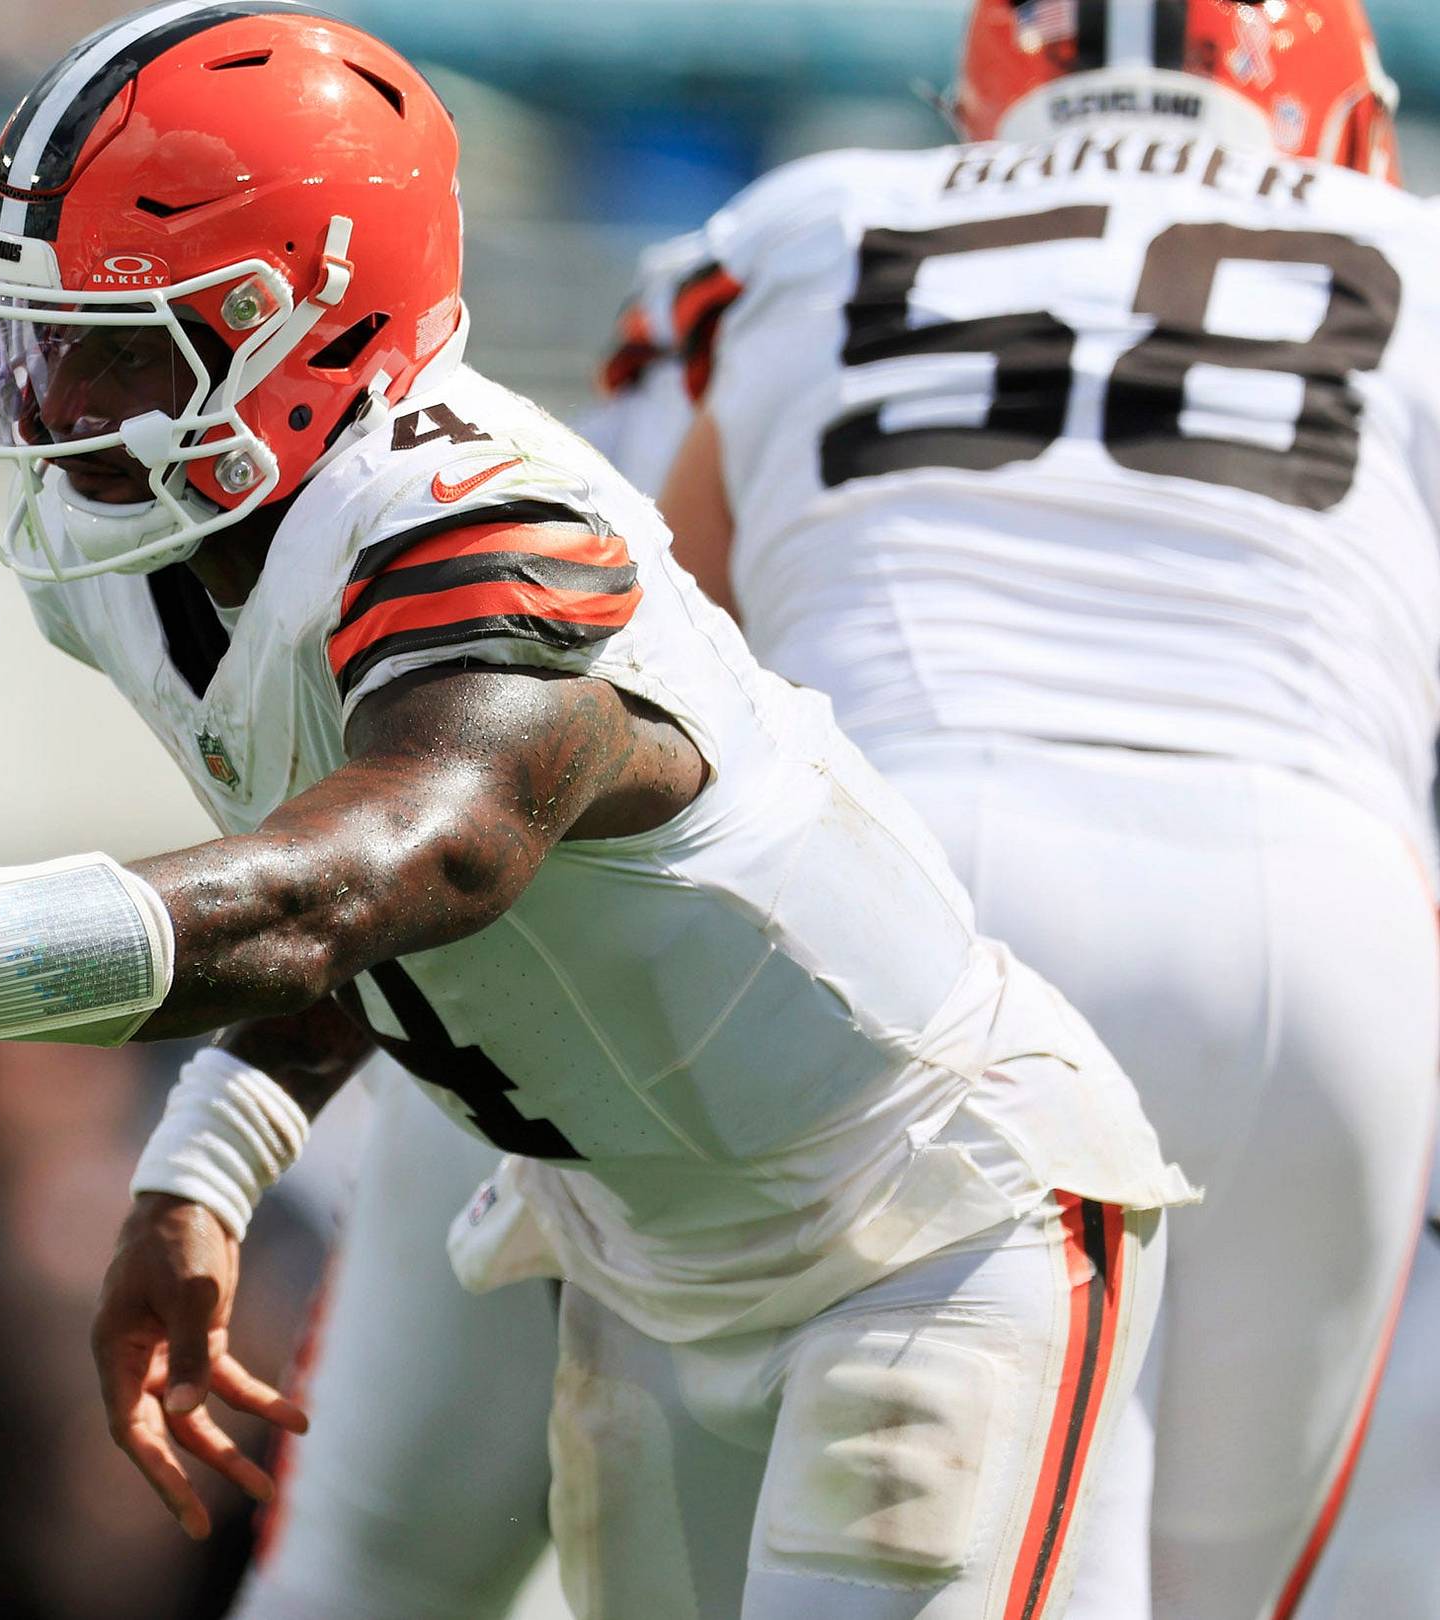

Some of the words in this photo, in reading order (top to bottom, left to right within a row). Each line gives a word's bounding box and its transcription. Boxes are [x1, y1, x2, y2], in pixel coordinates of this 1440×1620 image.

[942, 134, 1320, 202] BARBER
[92, 273, 165, 285] OAKLEY
[819, 205, 1402, 514] 58
[391, 402, 494, 451] 4
[330, 957, 591, 1162] 4
